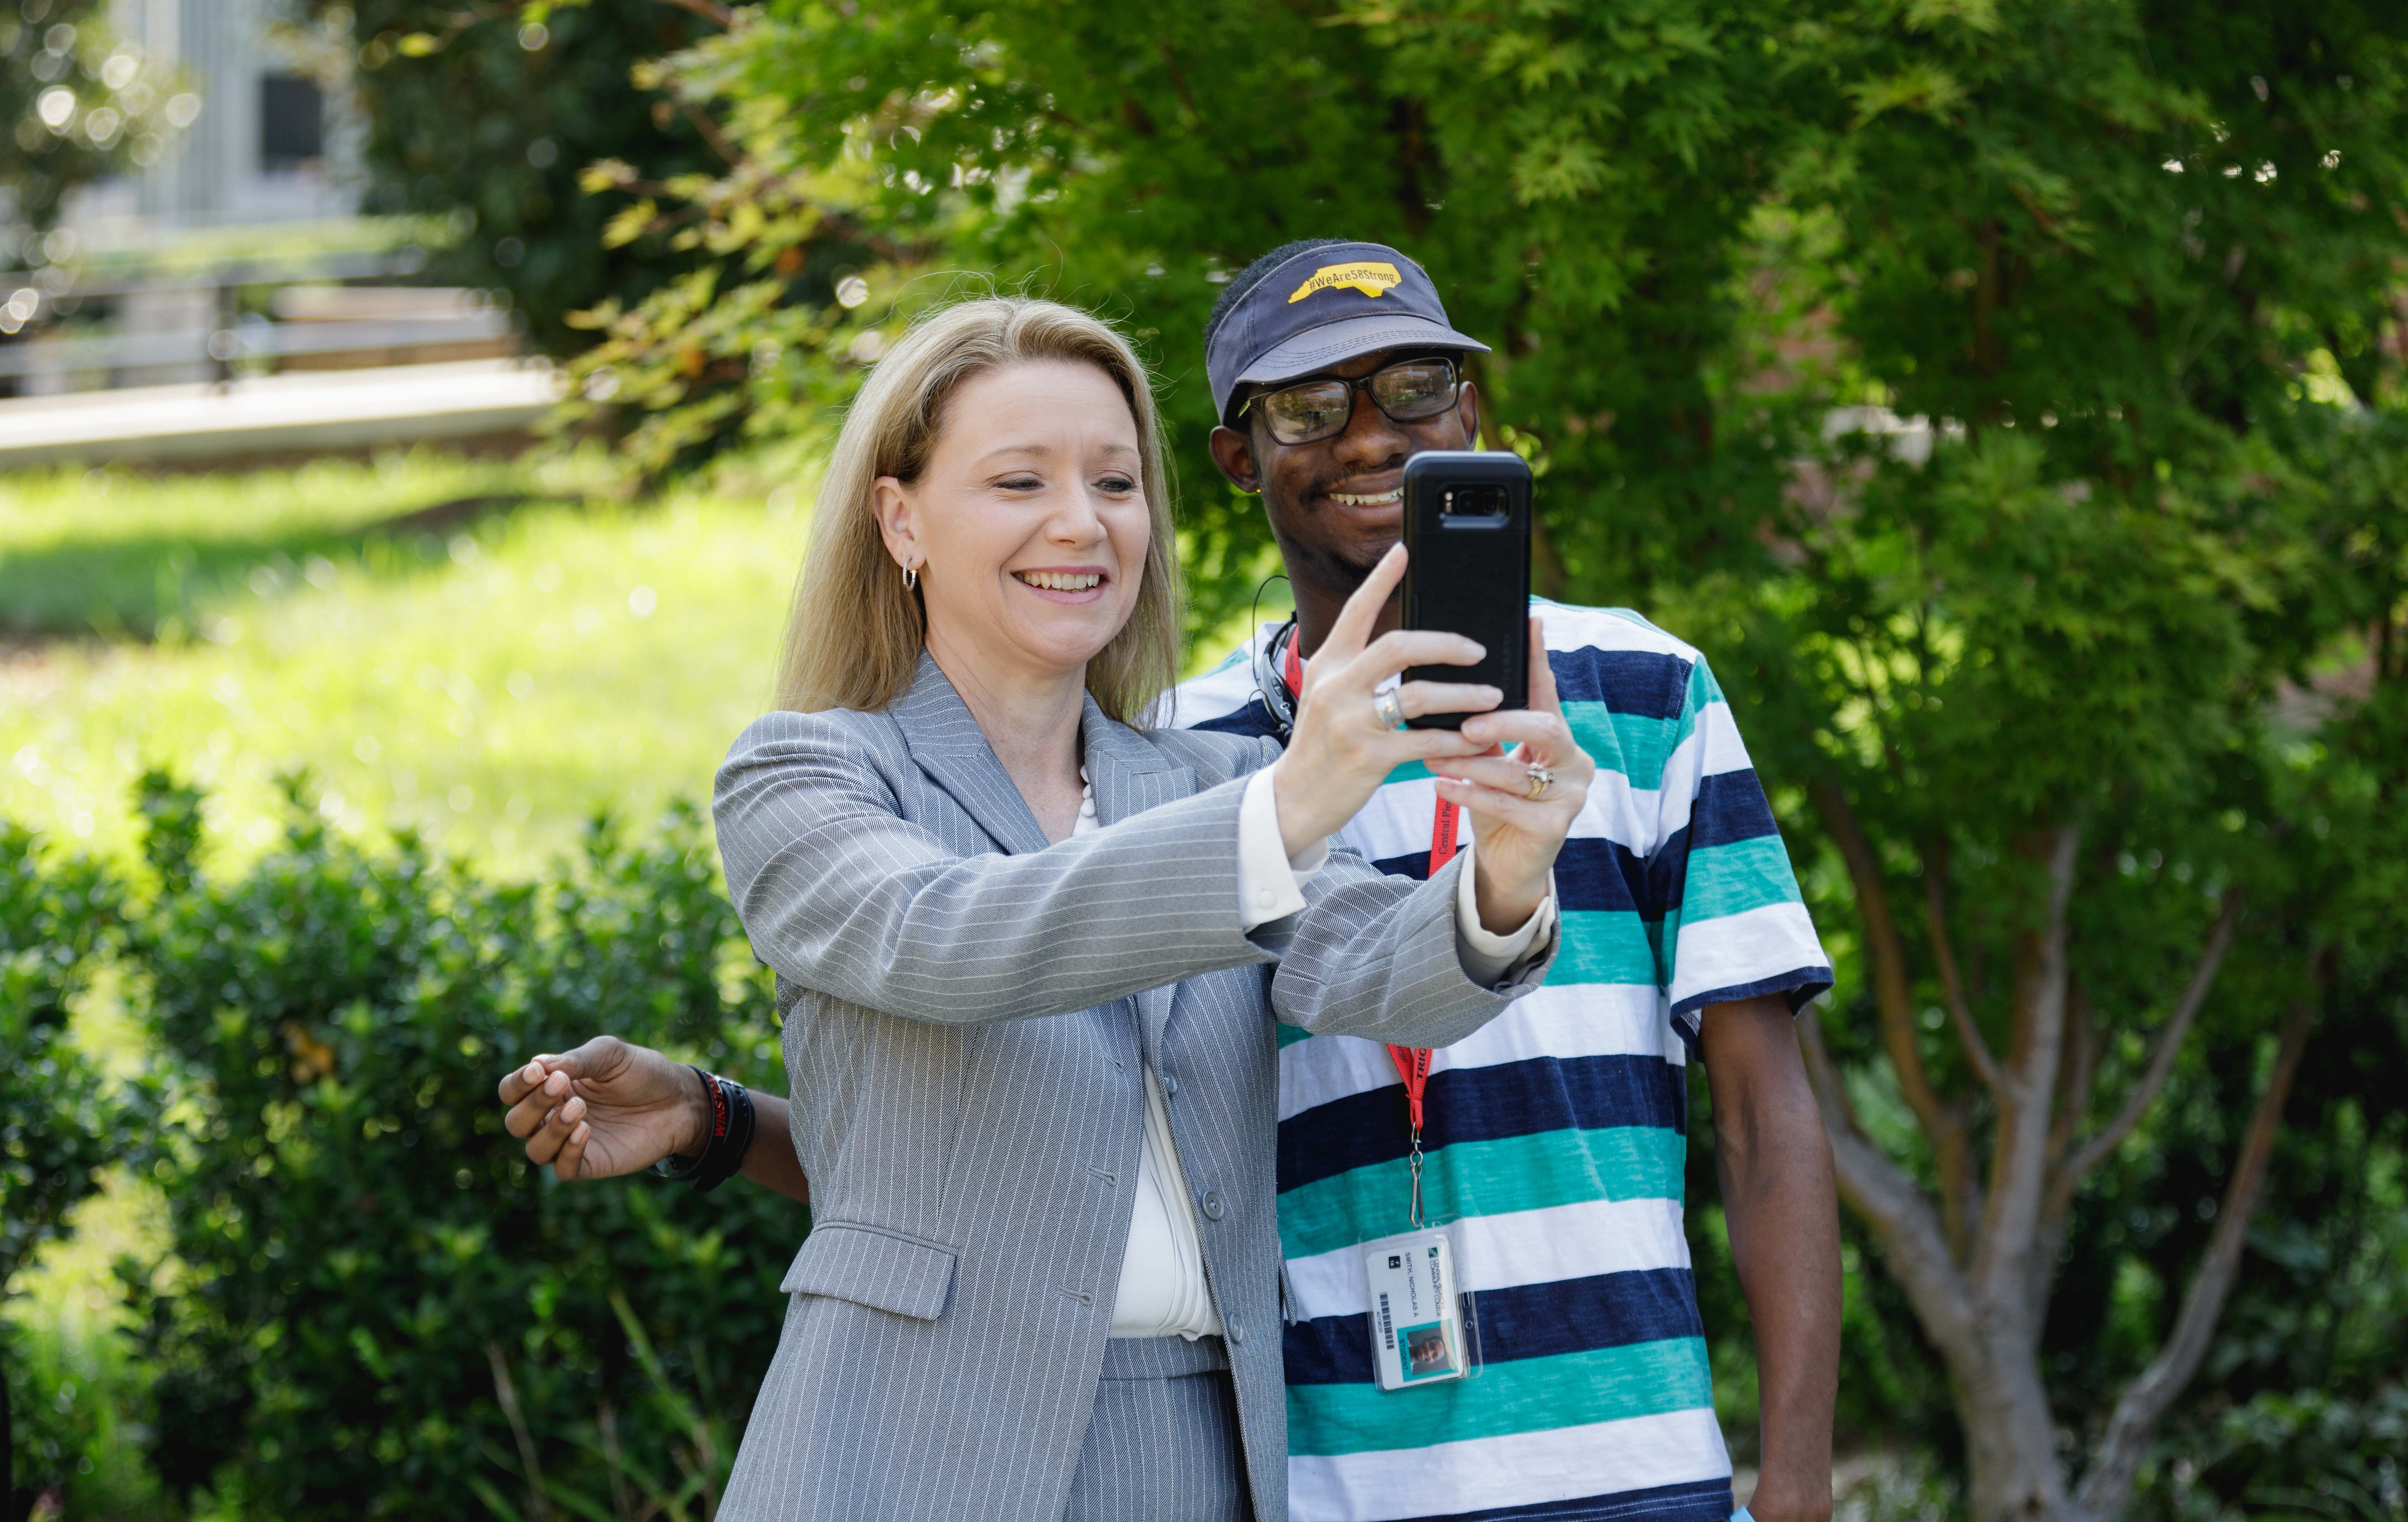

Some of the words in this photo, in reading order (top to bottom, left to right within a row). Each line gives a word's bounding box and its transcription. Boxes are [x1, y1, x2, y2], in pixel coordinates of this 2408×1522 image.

[1309, 270, 1396, 291] #WeAre58Strong
[1442, 800, 1451, 817] Pie
[1439, 820, 1450, 854] Central
[1430, 1260, 1439, 1293] COMMUNITY
[1409, 1276, 1418, 1311] NICHOLAS
[1438, 1283, 1446, 1309] PIEDMONT
[1399, 1339, 1408, 1370] STUDENT
